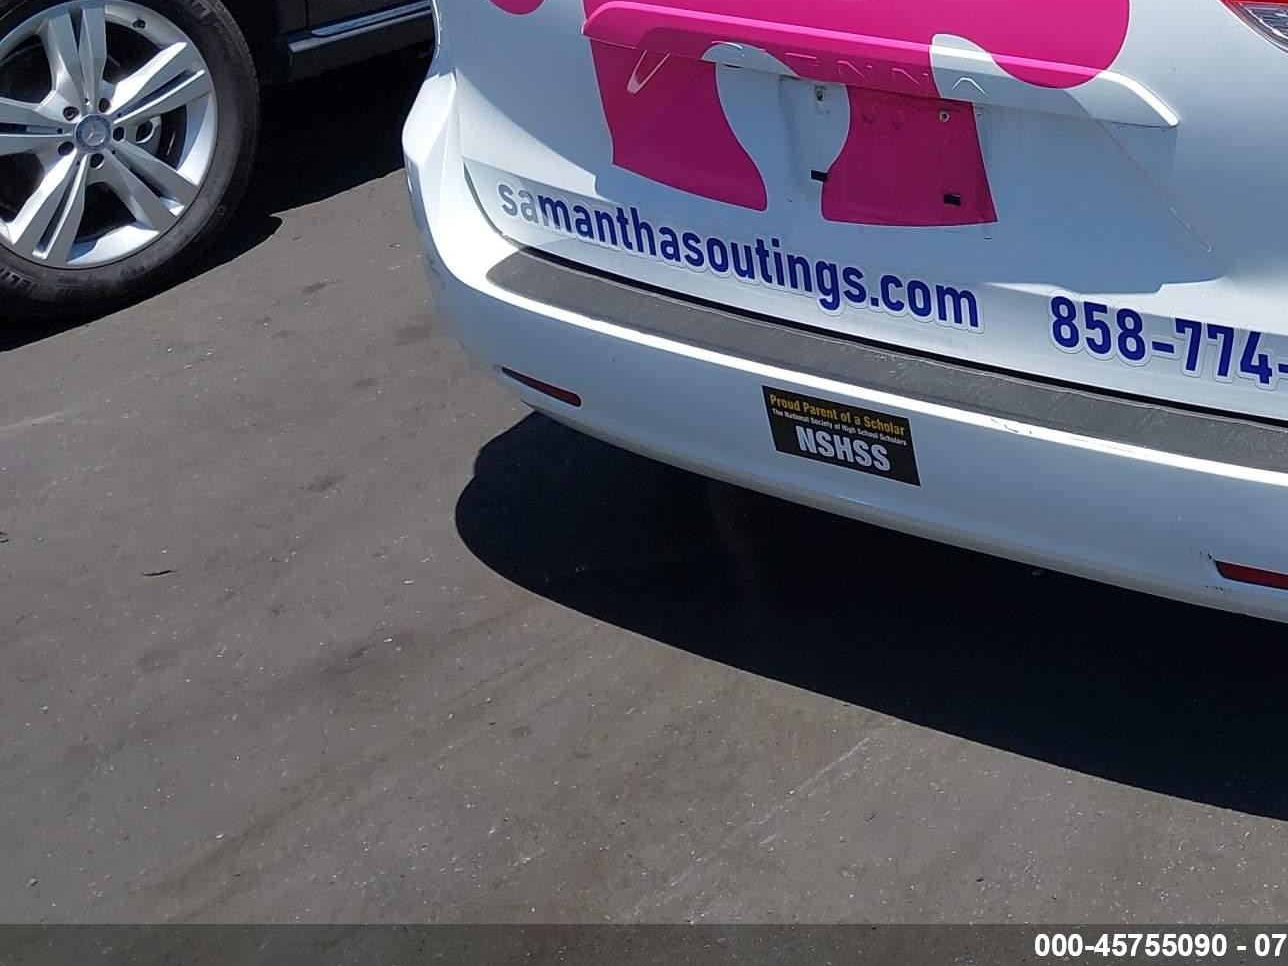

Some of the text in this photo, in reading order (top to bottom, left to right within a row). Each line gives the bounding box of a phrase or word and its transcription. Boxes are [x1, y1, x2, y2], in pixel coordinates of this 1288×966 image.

[498, 183, 981, 328] samanthasoutings.com
[769, 394, 905, 436] Proud Parent of a Scholar
[795, 425, 891, 472] NSHSS
